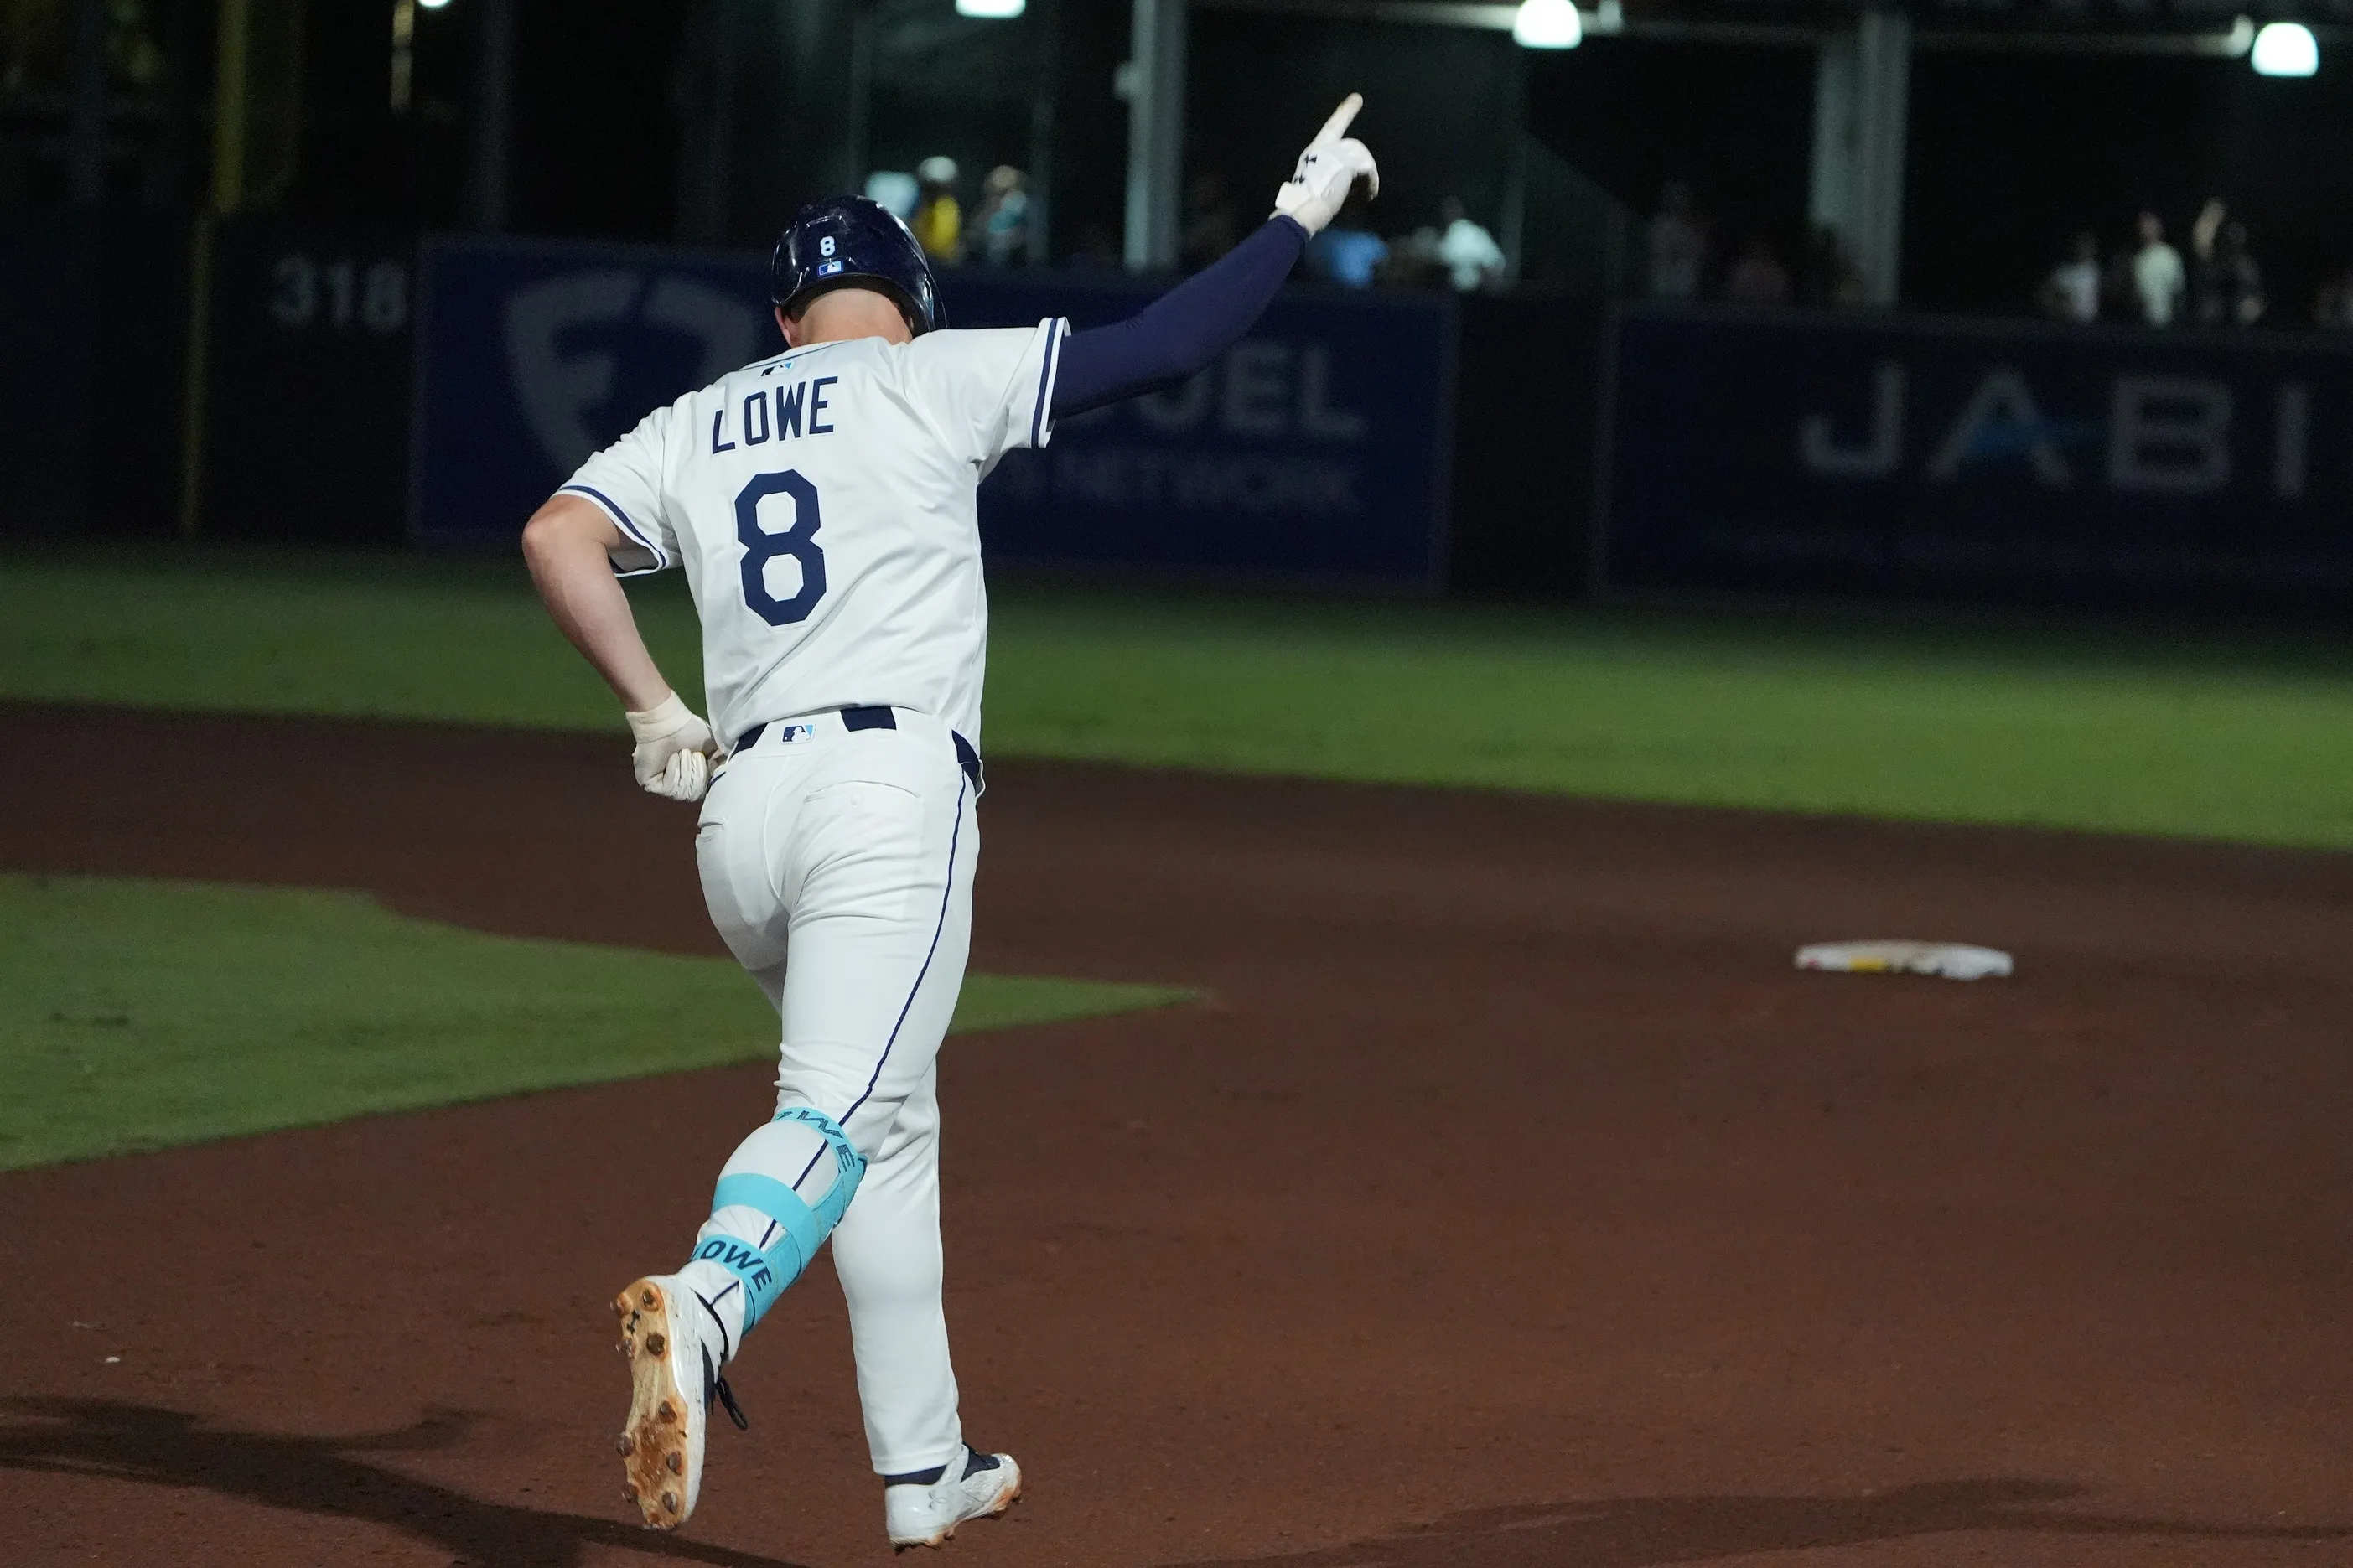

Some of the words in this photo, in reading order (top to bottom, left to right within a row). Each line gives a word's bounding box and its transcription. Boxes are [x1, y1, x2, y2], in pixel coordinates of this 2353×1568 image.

[820, 235, 836, 256] 8
[271, 254, 408, 332] 318
[712, 376, 838, 454] LOWE
[1796, 359, 2310, 499] JABI
[734, 469, 827, 627] 8
